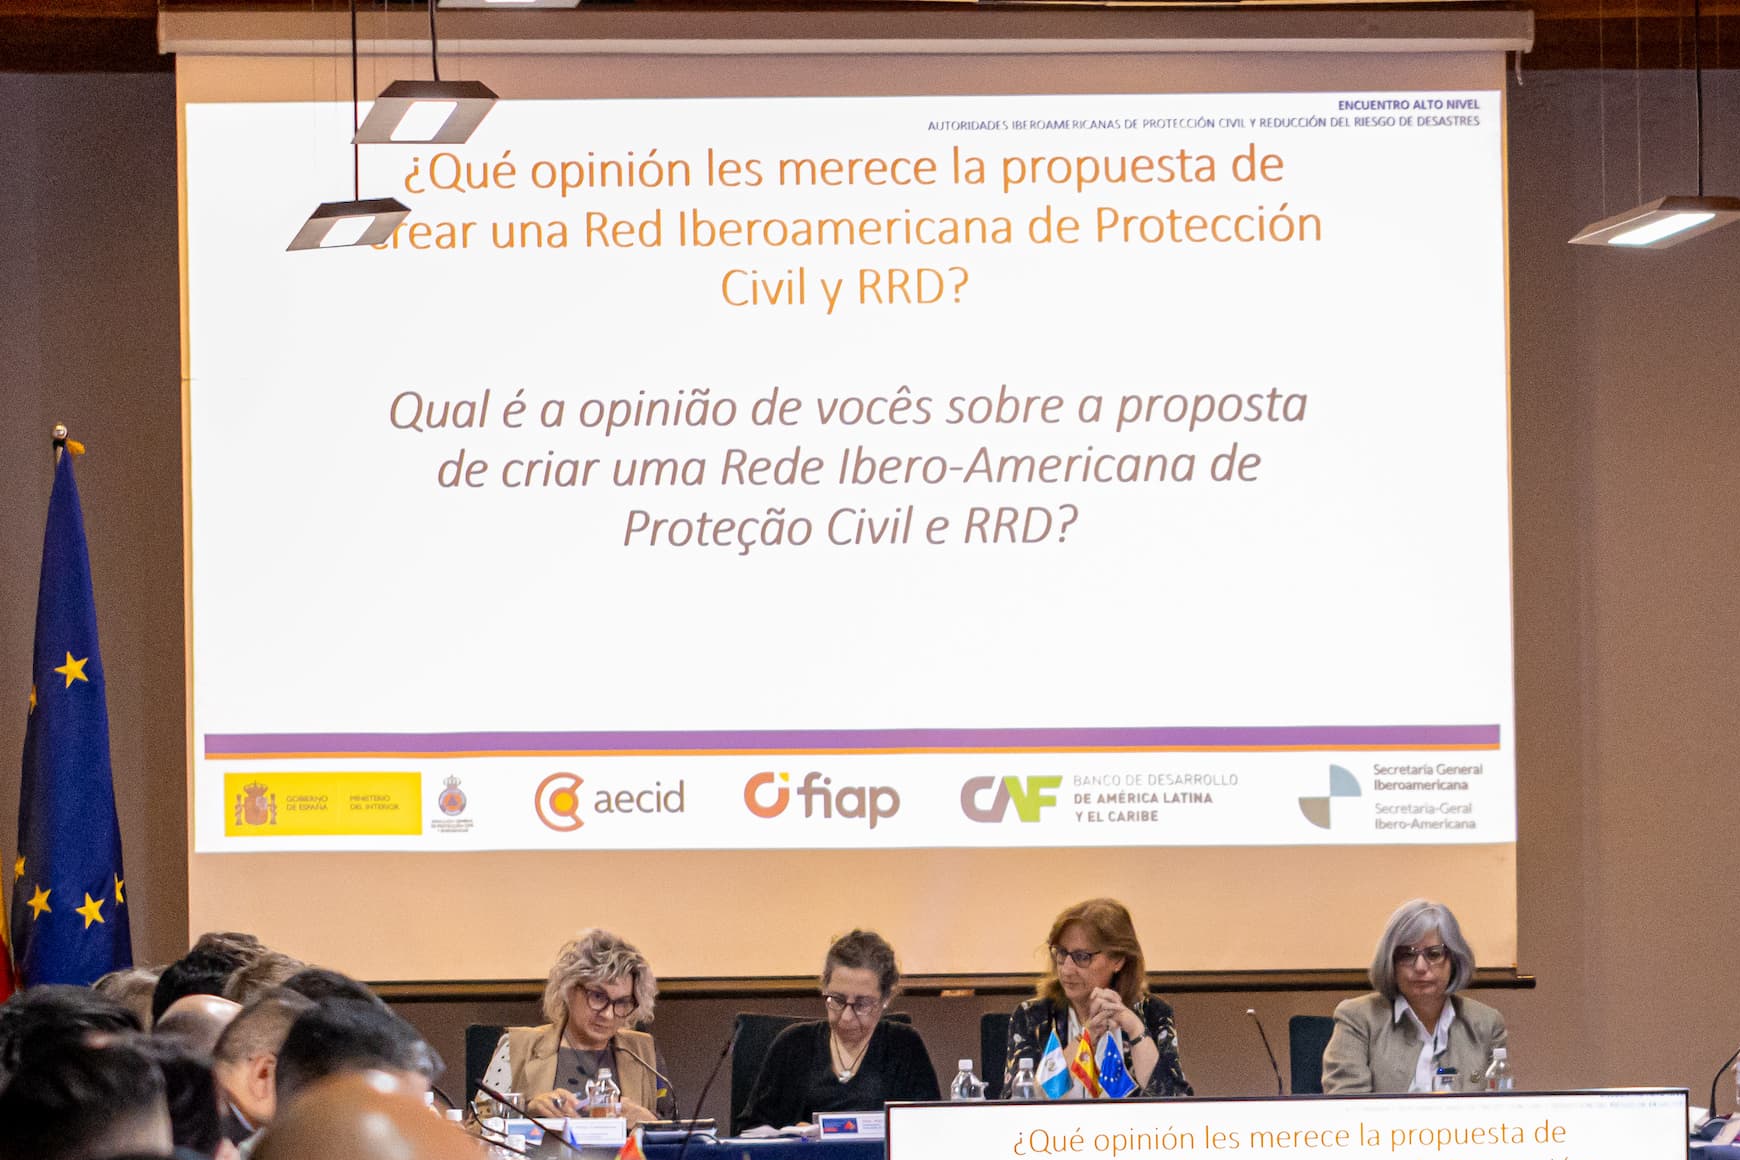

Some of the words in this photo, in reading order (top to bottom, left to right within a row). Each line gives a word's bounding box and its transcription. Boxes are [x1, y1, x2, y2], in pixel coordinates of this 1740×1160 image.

[1339, 100, 1410, 110] ENCUENTRO
[1413, 99, 1443, 110] ALTO
[1446, 99, 1480, 109] NIVEL
[928, 121, 1008, 131] AUTORIDADES
[1012, 120, 1120, 130] IBEROAMERICANAS
[1125, 119, 1139, 129] DE
[1143, 116, 1215, 128] PROTECCIÓN
[1219, 118, 1245, 128] CIVIL
[1250, 118, 1256, 128] Y
[1260, 115, 1327, 128] REDUCCIÓN
[1330, 117, 1350, 127] DEL
[1354, 116, 1396, 127] RIESGO
[1399, 116, 1413, 127] DE
[1417, 115, 1480, 127] DESASTRES
[404, 151, 517, 194] ¿Qué
[531, 148, 691, 198] opinión
[708, 148, 763, 187] les
[779, 157, 937, 186] merece
[953, 145, 985, 184] la
[1003, 149, 1216, 194] propuesta
[1232, 142, 1284, 182] de
[370, 220, 477, 249] rear
[492, 221, 568, 249] una
[586, 208, 662, 248] Red
[680, 208, 1012, 247] Iberoamericana
[1029, 204, 1080, 244] de
[1097, 202, 1321, 243] Protección
[722, 267, 805, 307] Civil
[820, 278, 843, 315] y
[859, 266, 969, 304] RRD?
[390, 389, 491, 432] Qual
[503, 388, 526, 428] é
[540, 400, 565, 428] a
[580, 388, 737, 437] opinião
[752, 386, 802, 426] de
[817, 385, 932, 425] vocês
[945, 384, 1064, 424] sobre
[1078, 395, 1103, 423] a
[1116, 387, 1307, 432] proposta
[438, 448, 488, 488] de
[502, 450, 600, 488] criar
[613, 458, 706, 487] uma
[721, 445, 824, 485] Rede
[839, 445, 1195, 485] Ibero-Americana
[1211, 442, 1261, 482] de
[624, 507, 812, 556] Proteção
[828, 505, 913, 545] Civil
[926, 516, 949, 545] e
[964, 504, 1079, 544] RRD?
[1074, 775, 1120, 786] BANCO
[1126, 774, 1142, 785] DE
[1148, 774, 1238, 786] DESARROLLO
[1374, 779, 1469, 791] Iberoamericana
[1436, 764, 1483, 775] General
[594, 779, 685, 814] aecid
[797, 771, 900, 829] fiap
[1074, 793, 1091, 804] DE
[1097, 790, 1158, 804] AMÉRICA
[1164, 792, 1213, 803] LATINA
[1076, 812, 1083, 822] Y
[1088, 811, 1104, 822] EL
[1108, 810, 1158, 822] CARIBE
[1375, 818, 1476, 829] Ibero-Americana
[1013, 1127, 1086, 1156] ¿Qué
[1094, 1125, 1194, 1158] opinión
[1205, 1125, 1240, 1150] les
[1250, 1130, 1350, 1149] merece
[1359, 1122, 1380, 1146] la
[1391, 1123, 1524, 1152] propuesta
[1534, 1119, 1567, 1144] de
